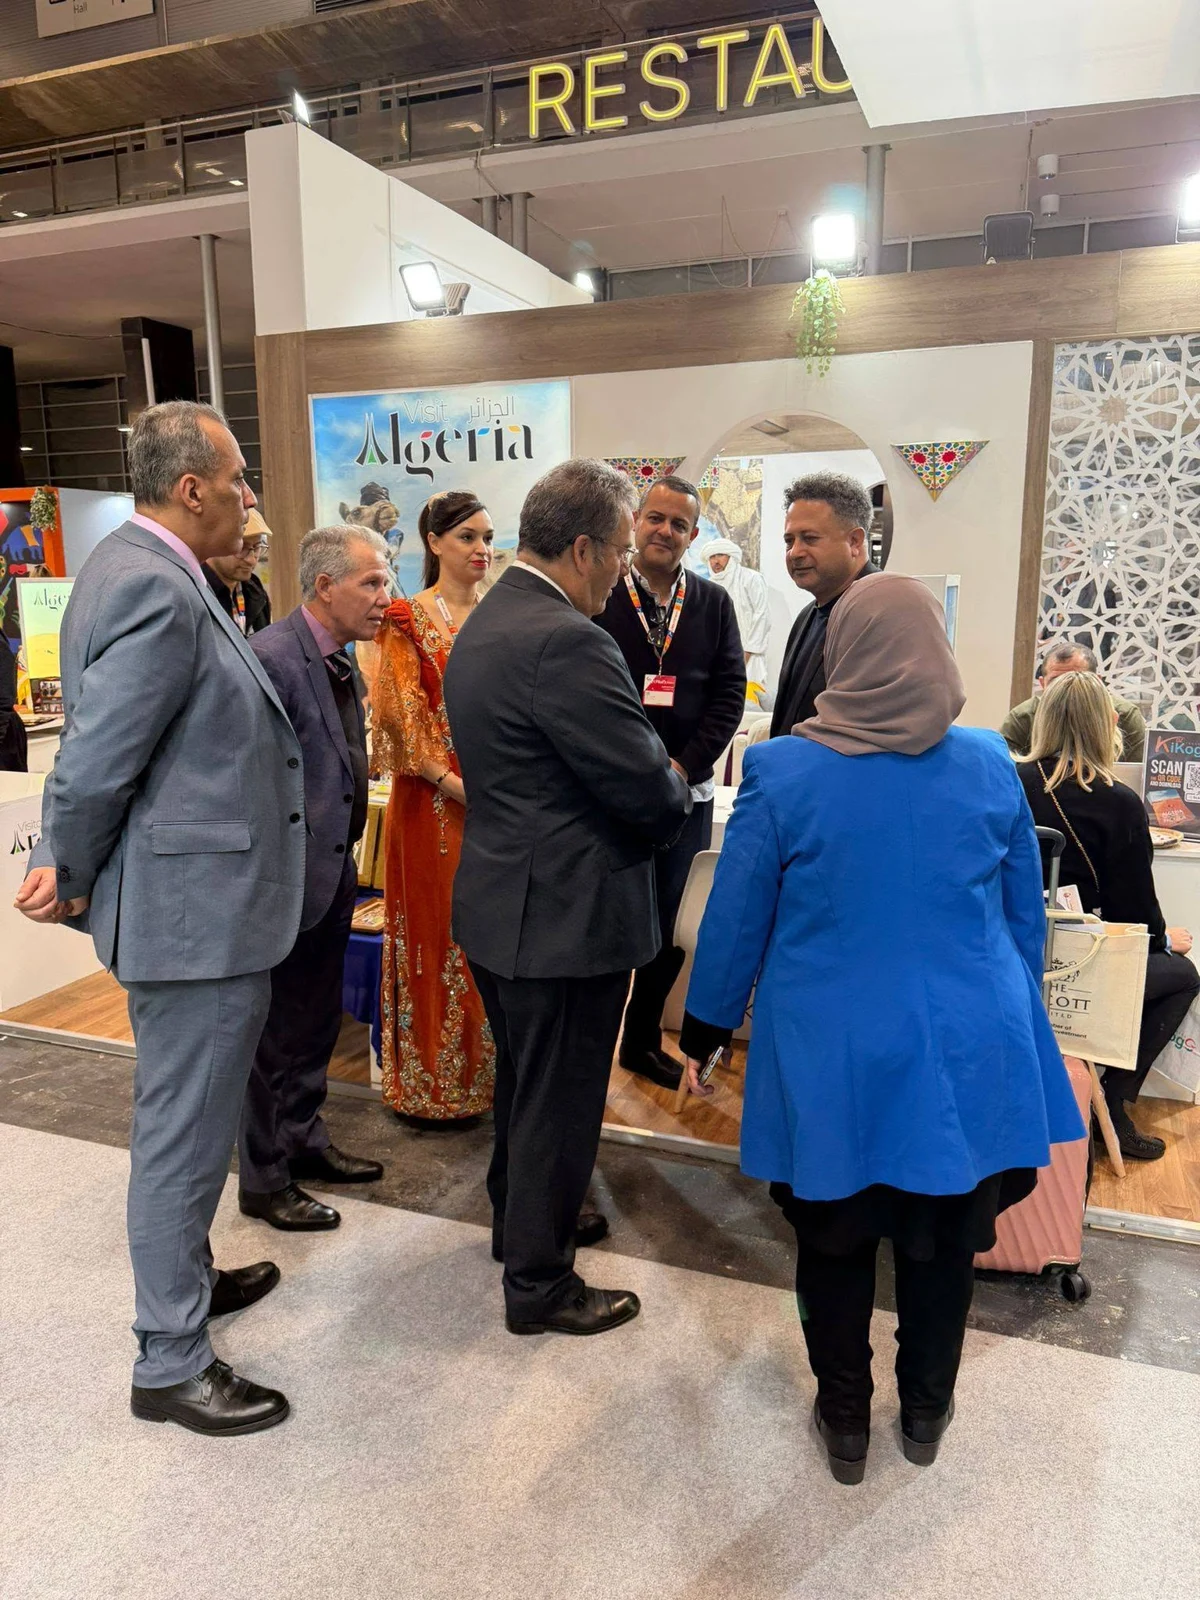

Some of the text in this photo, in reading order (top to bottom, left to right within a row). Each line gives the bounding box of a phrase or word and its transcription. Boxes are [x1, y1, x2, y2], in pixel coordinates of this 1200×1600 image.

[73, 4, 88, 14] Hall
[403, 400, 449, 424] Visit
[467, 395, 515, 424] الجزائر
[355, 411, 534, 482] Algeria
[1150, 759, 1183, 776] SCAN
